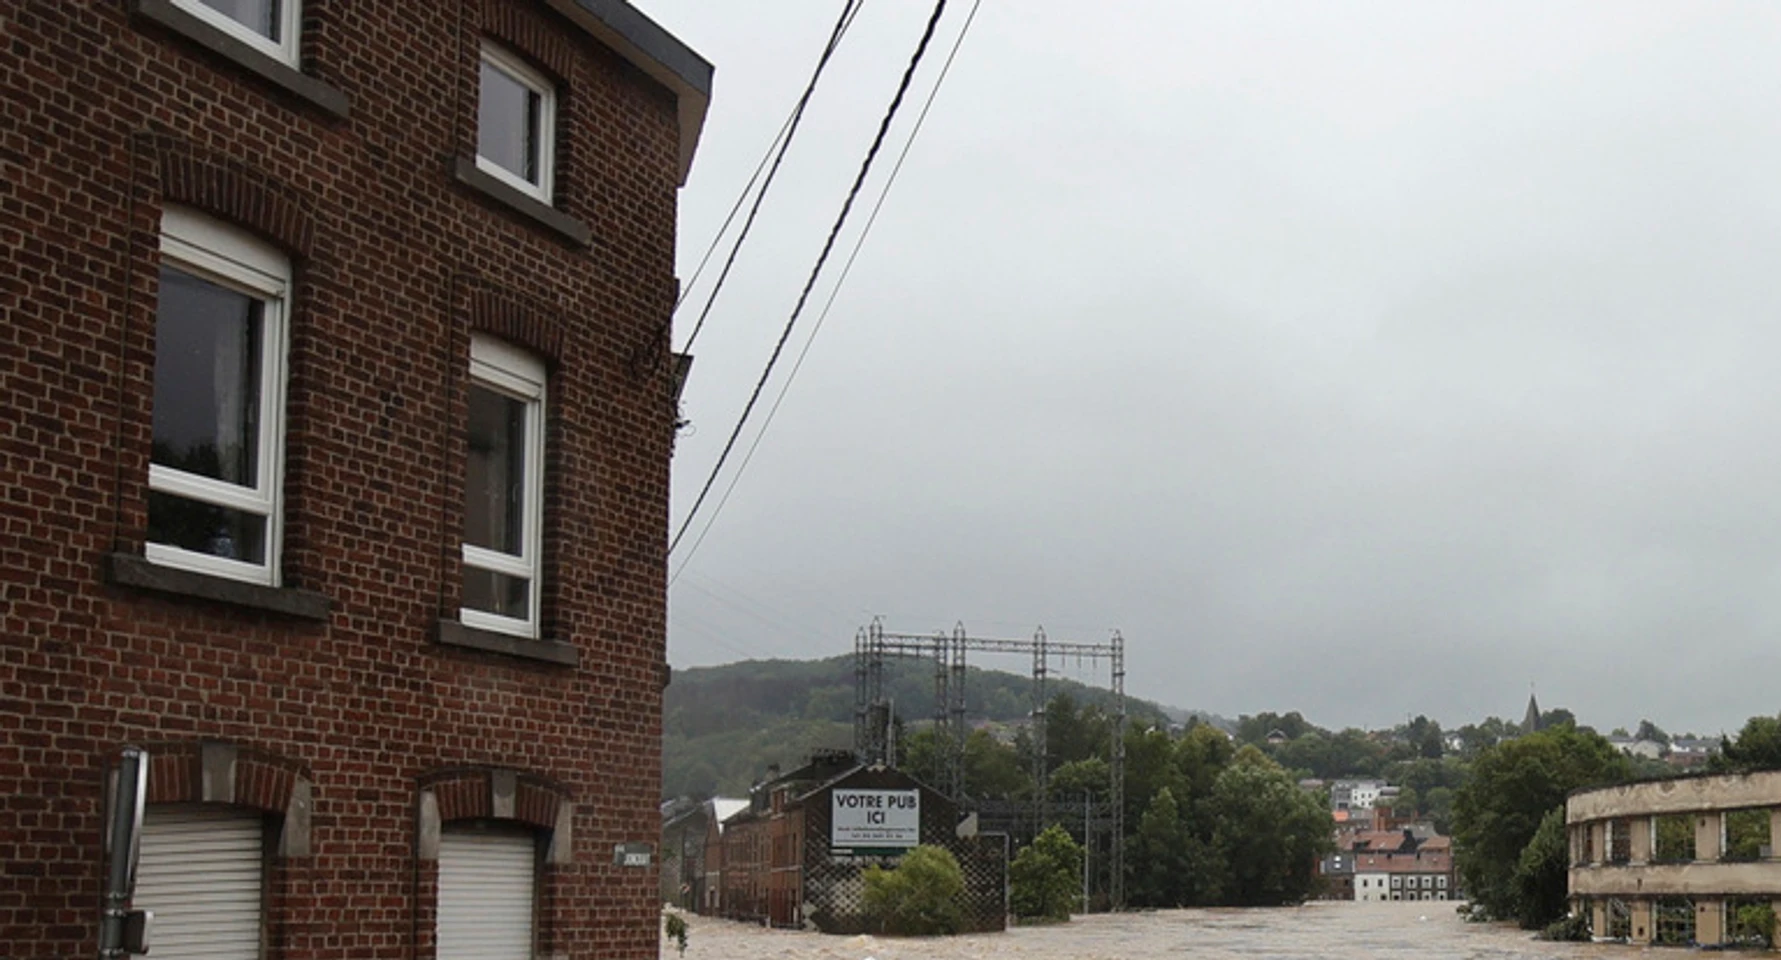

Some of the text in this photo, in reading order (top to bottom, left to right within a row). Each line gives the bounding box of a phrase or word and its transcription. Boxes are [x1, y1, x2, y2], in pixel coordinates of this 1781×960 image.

[836, 795, 917, 809] VOTRE PUB
[867, 811, 885, 824] ICI
